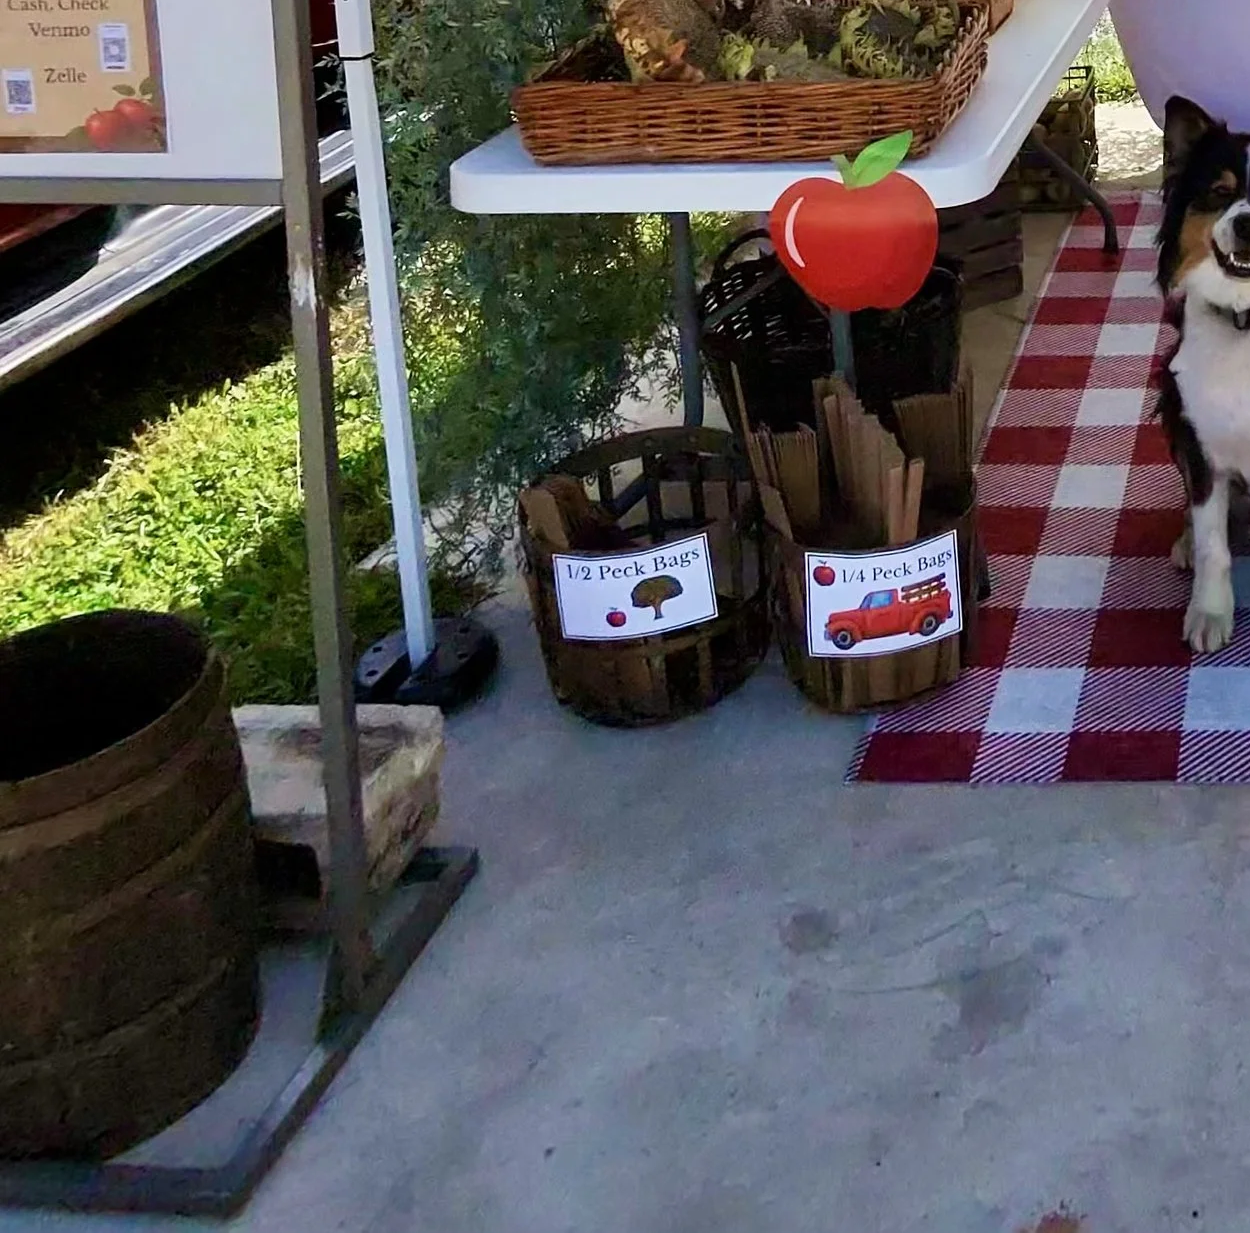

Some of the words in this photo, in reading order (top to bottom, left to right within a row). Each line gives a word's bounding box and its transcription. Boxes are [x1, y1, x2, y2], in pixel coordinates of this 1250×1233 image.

[28, 22, 91, 37] Venmo
[44, 68, 87, 84] Zelle
[566, 564, 592, 581] 1/2
[598, 561, 646, 580] Peck
[652, 548, 700, 573] Bags
[842, 569, 866, 583] 1/4
[873, 562, 912, 581] Peck
[918, 549, 952, 572] Bags
